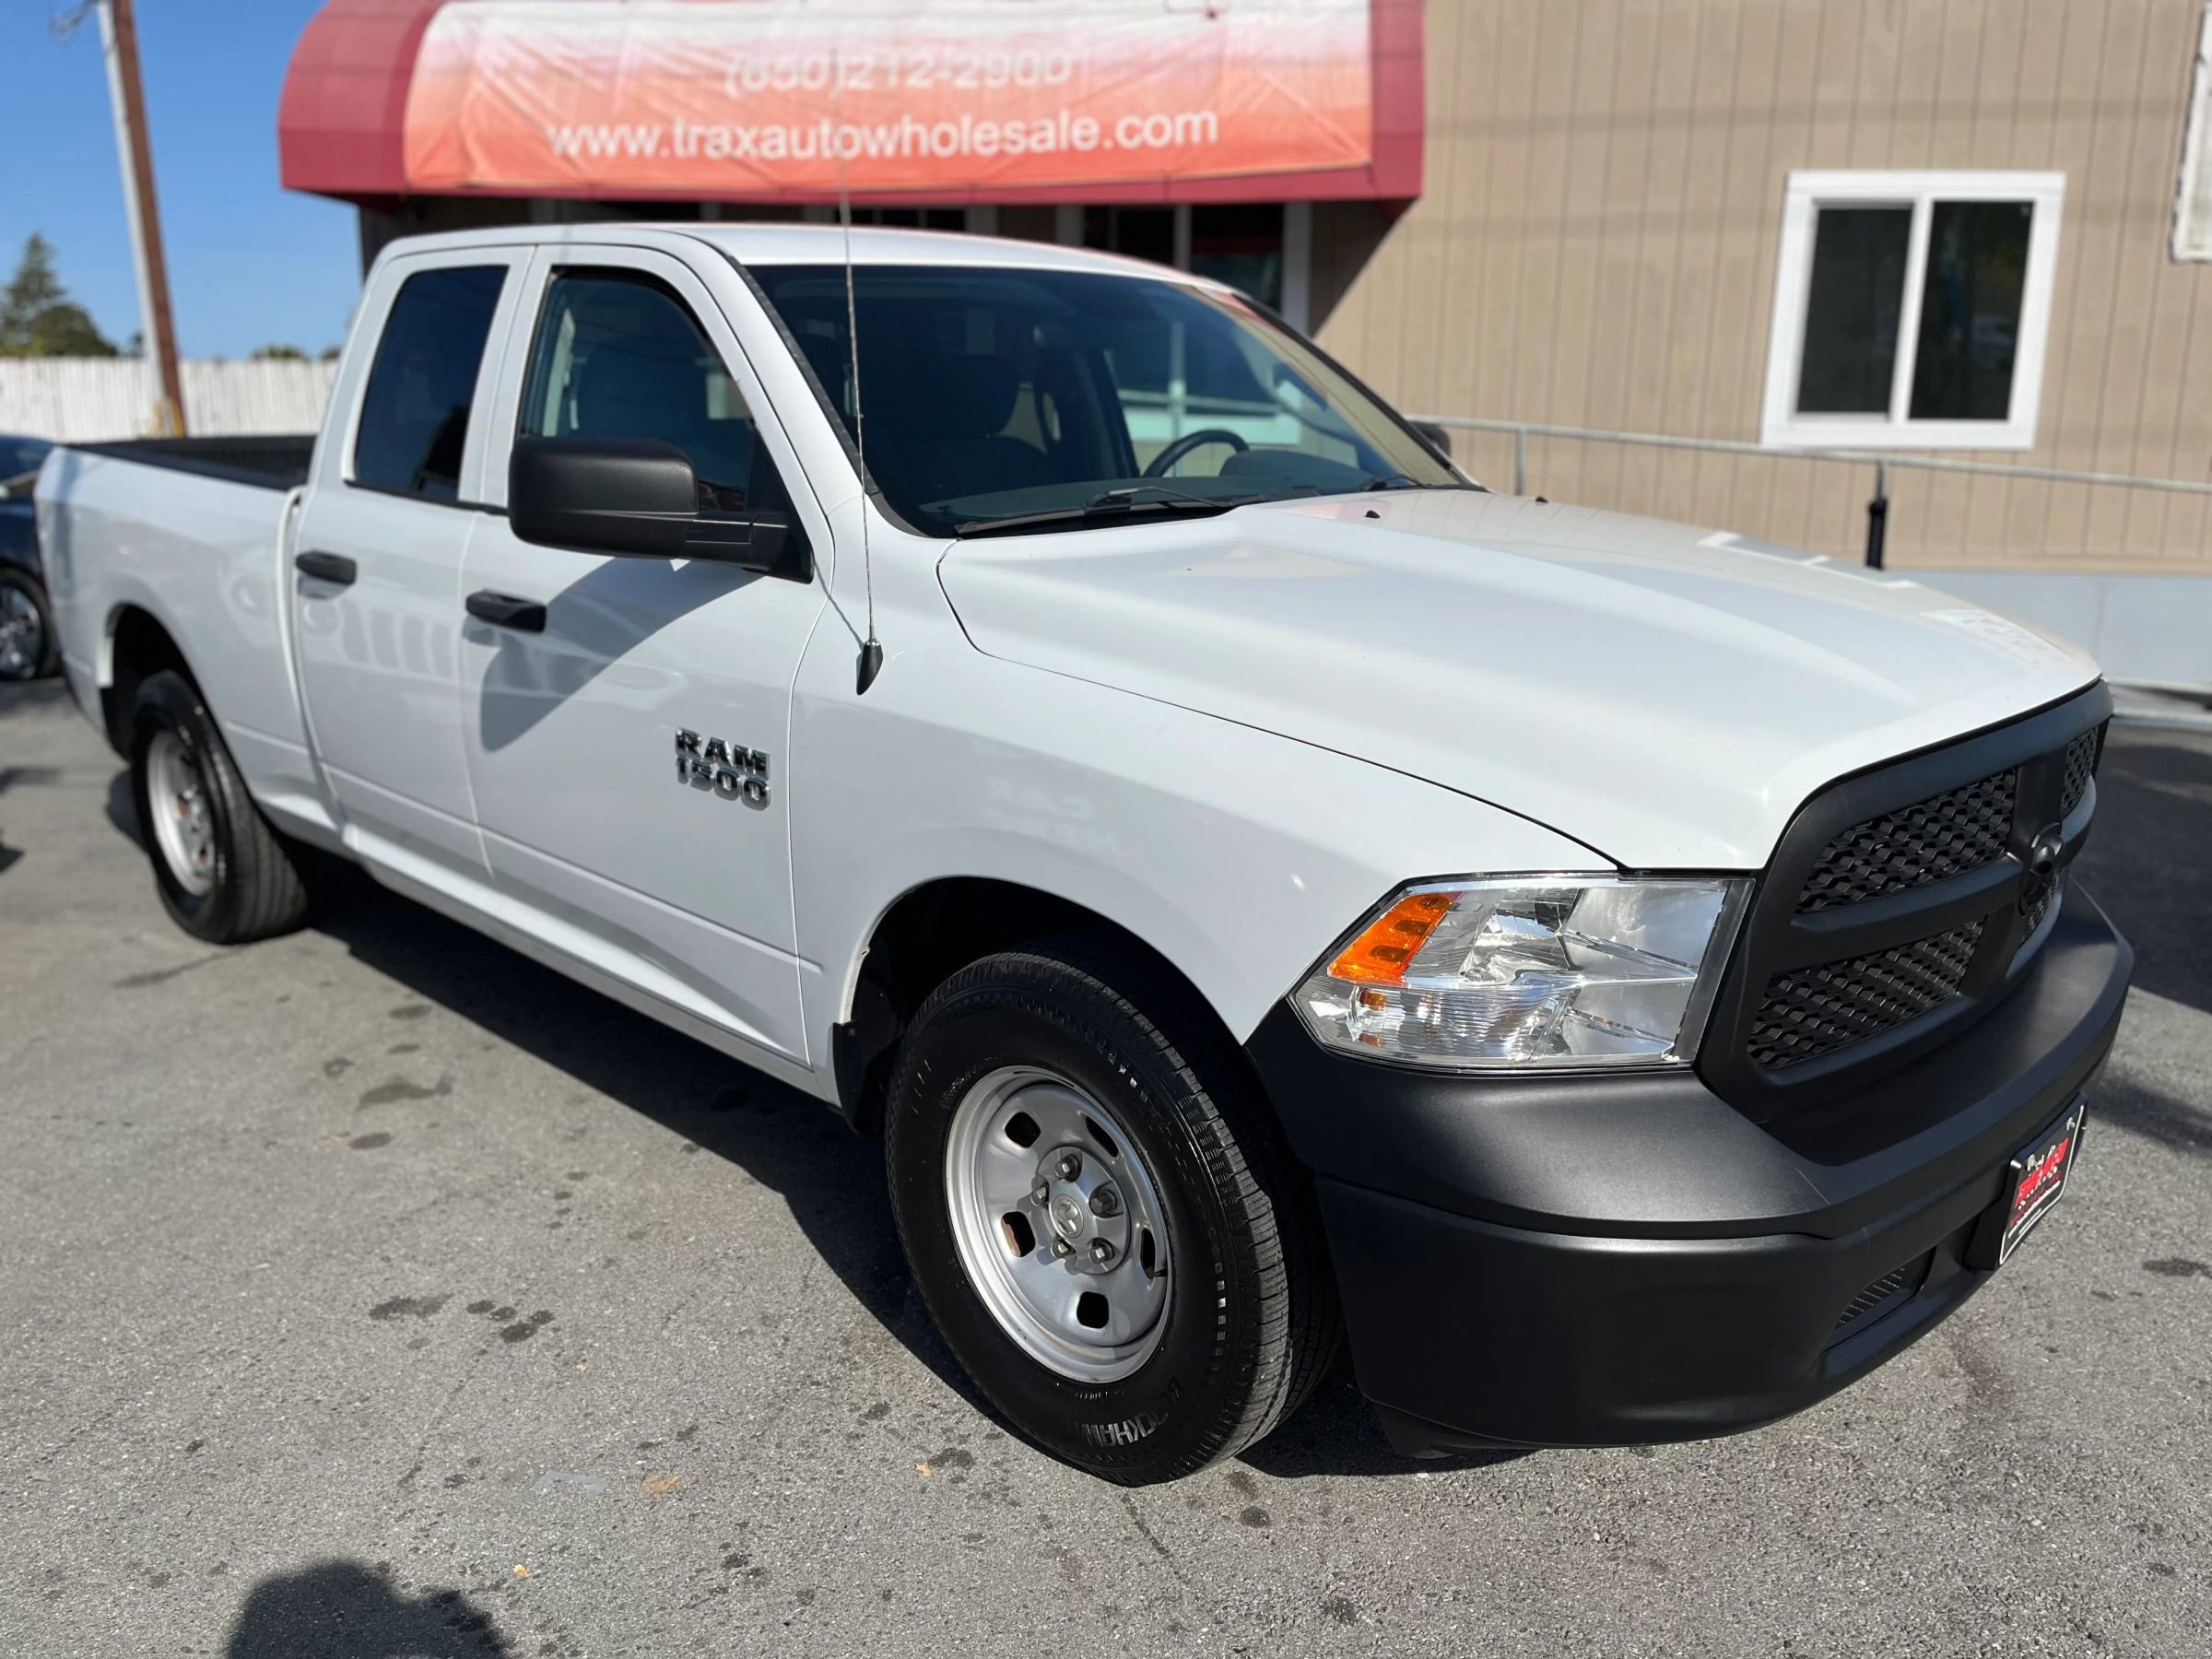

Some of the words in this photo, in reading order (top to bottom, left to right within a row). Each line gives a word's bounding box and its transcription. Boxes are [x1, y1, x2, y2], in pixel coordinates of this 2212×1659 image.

[724, 47, 1072, 99] (650)212-2900
[547, 108, 1219, 160] www.traxautowholesale.com
[675, 726, 771, 780] RAM
[677, 754, 771, 811] 1500
